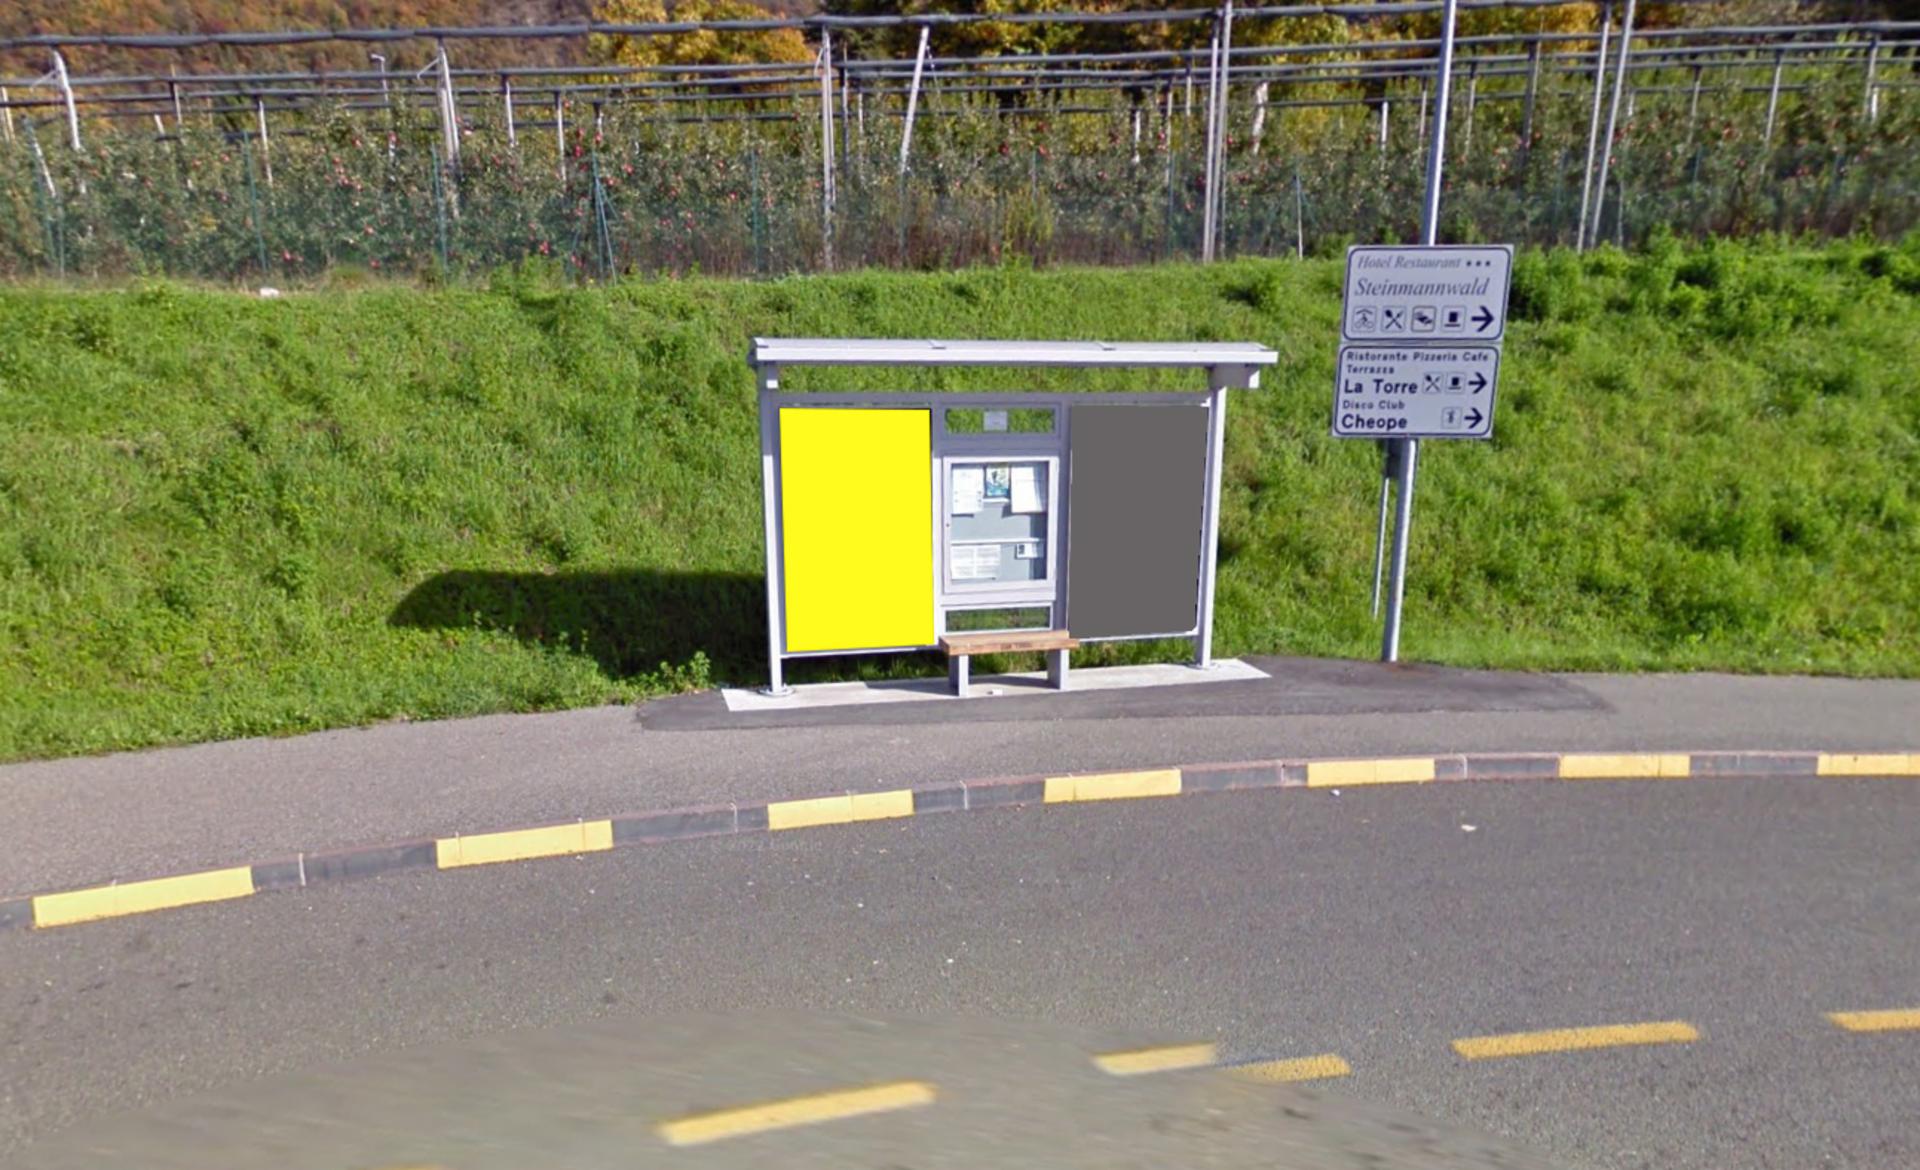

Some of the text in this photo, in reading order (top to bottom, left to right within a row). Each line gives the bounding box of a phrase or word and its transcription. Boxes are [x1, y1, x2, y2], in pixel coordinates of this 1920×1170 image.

[1357, 255, 1461, 269] Hotel Restaurant
[1354, 277, 1490, 296] Steinmannwald
[1346, 351, 1408, 362] Ristorante
[1413, 351, 1458, 362] Pizzeria
[1343, 379, 1418, 394] La Torre
[1342, 400, 1405, 410] Disco Club
[1341, 413, 1408, 431] Cheope
